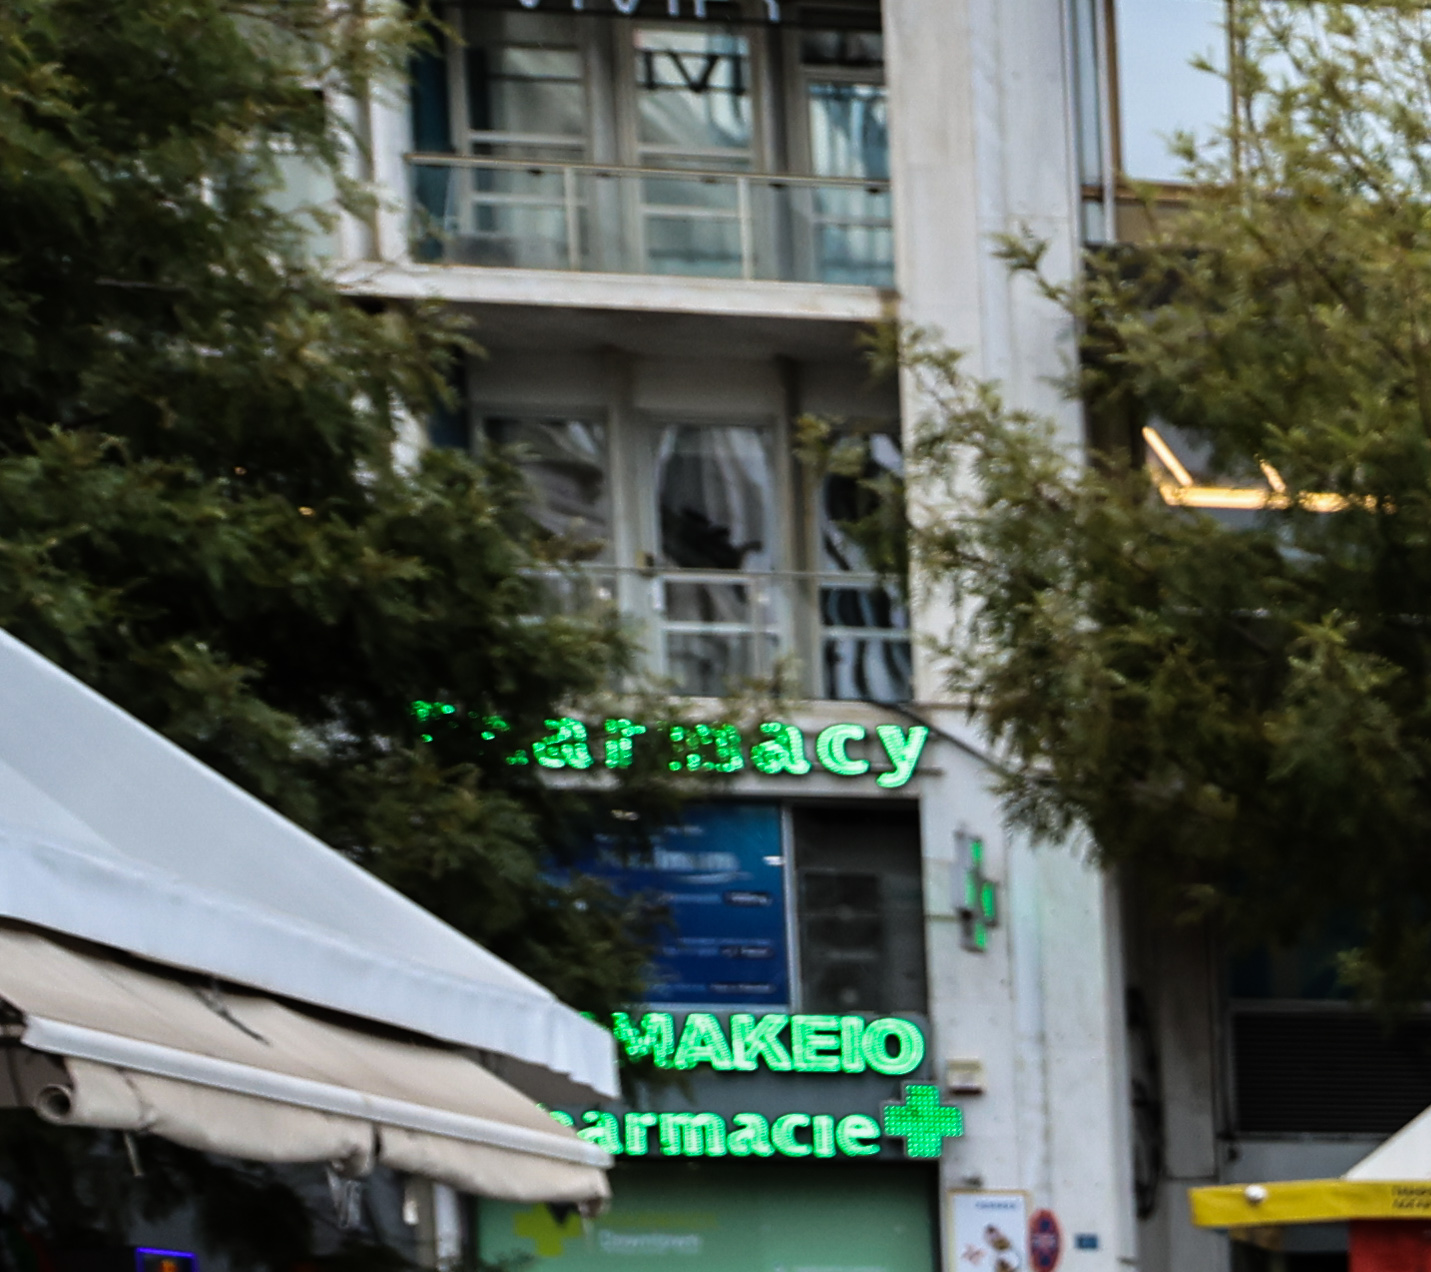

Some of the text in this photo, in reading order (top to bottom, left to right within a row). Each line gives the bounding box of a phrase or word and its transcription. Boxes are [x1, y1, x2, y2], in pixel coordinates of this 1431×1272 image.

[411, 700, 929, 788] armacy
[582, 1011, 926, 1076] ΜΑΚΕΙΟ
[540, 1106, 880, 1158] armacie
